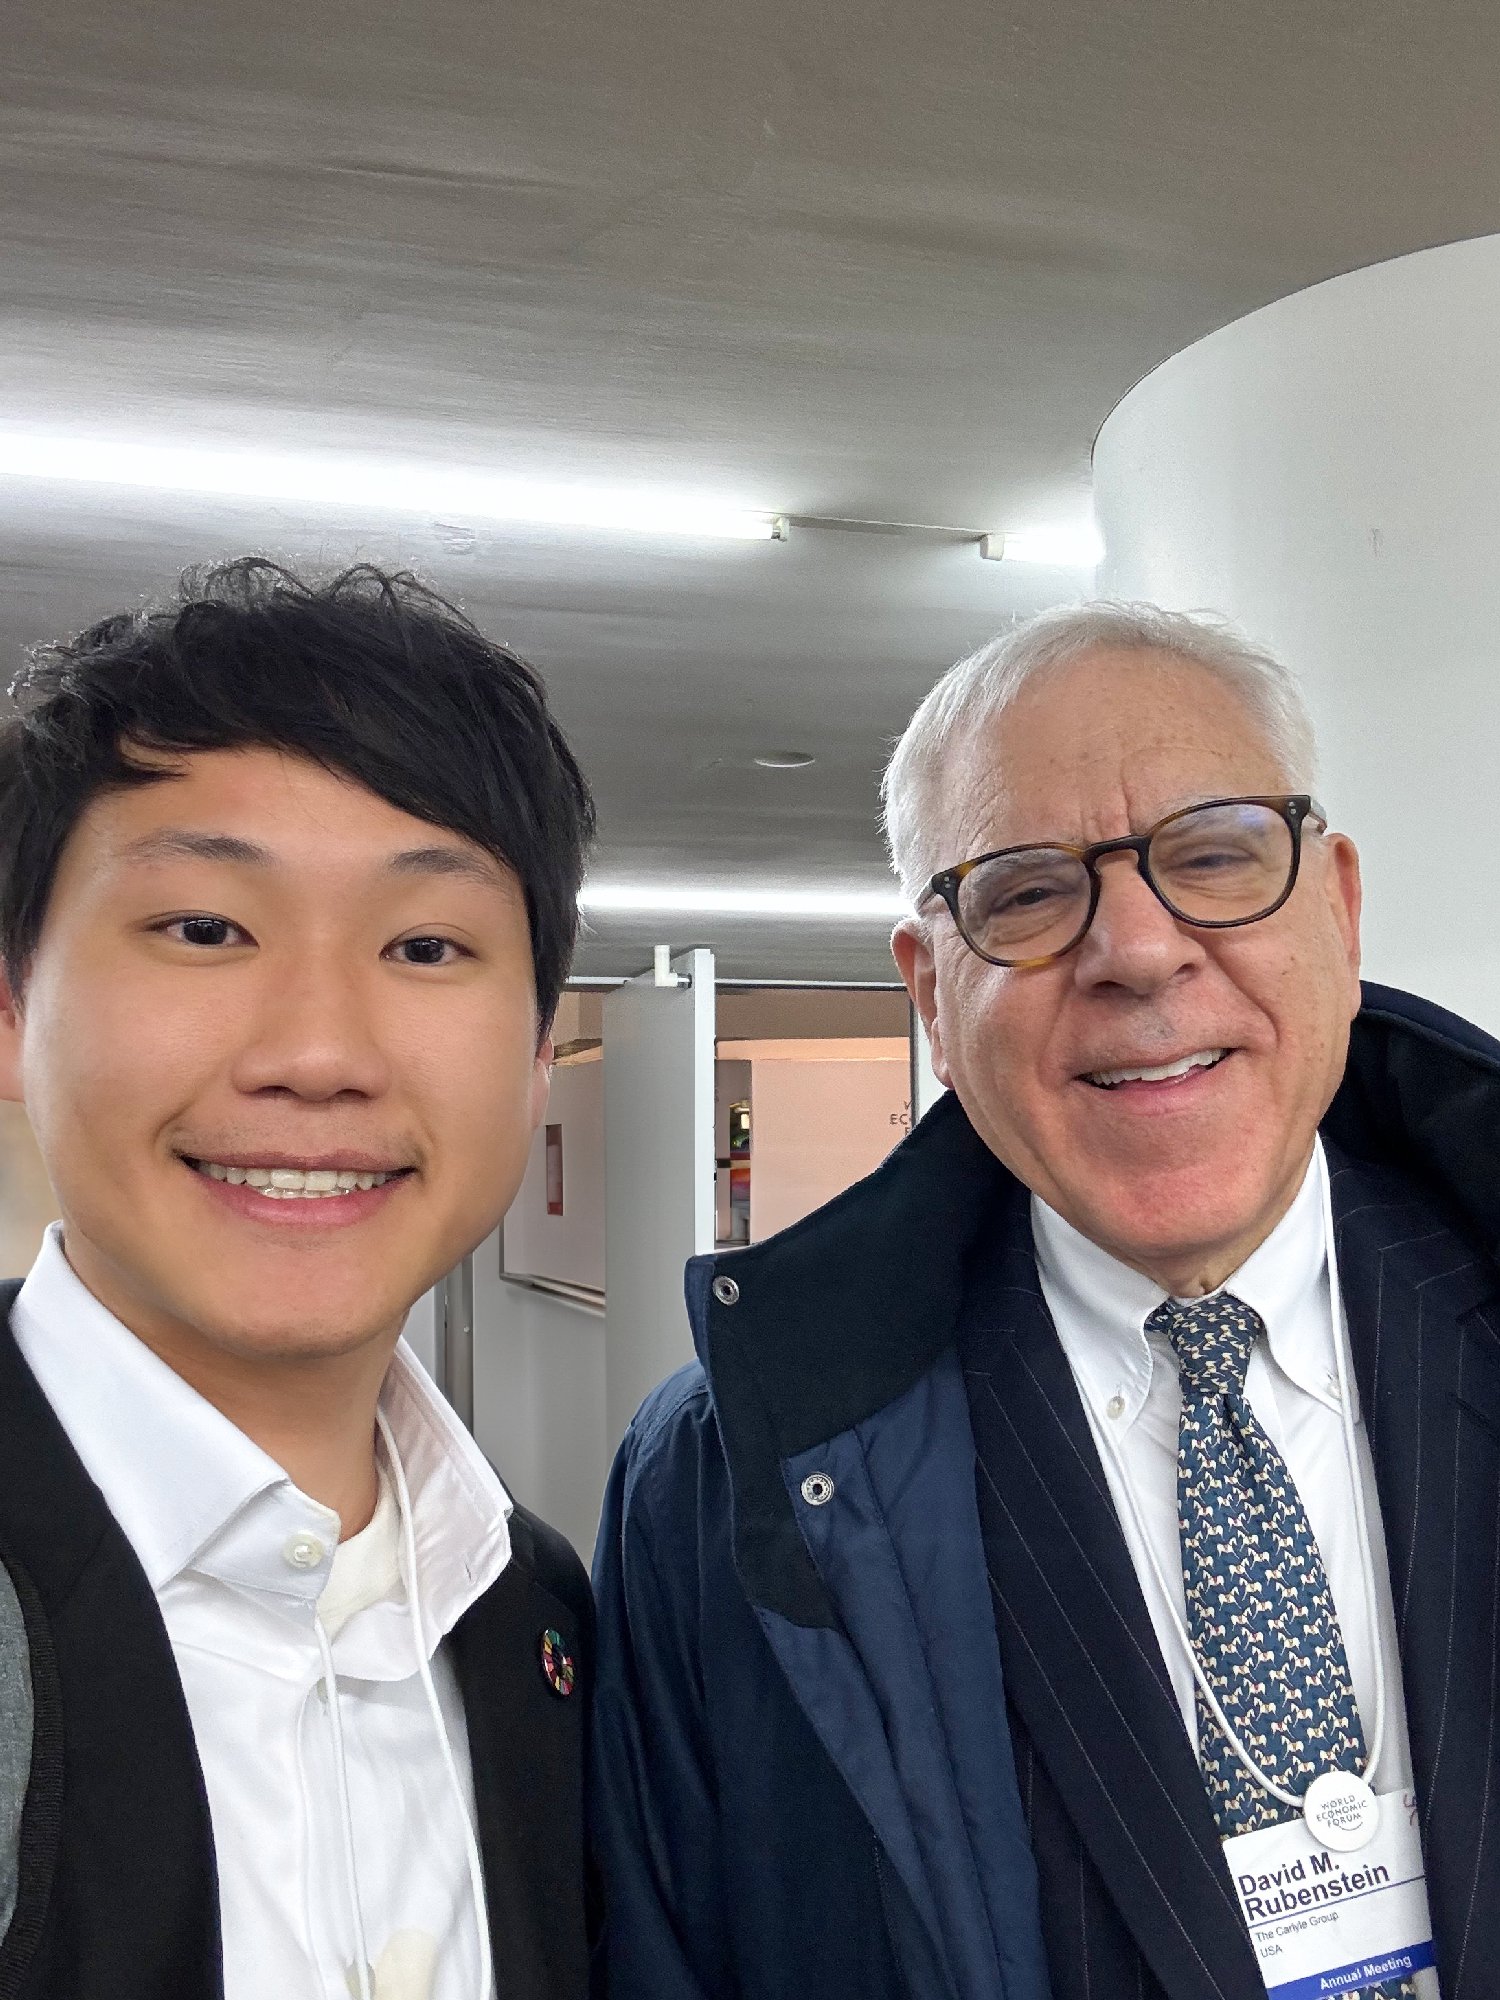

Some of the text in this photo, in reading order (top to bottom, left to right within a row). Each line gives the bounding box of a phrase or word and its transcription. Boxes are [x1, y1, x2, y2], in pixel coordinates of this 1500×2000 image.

[1316, 1800, 1368, 1822] ECONOMIC
[1321, 1795, 1356, 1810] WORLD
[1327, 1813, 1362, 1828] FORUM
[1238, 1852, 1340, 1897] David M.
[1244, 1864, 1391, 1921] Rubenstein
[1255, 1911, 1340, 1943] The Carlyle Group
[1260, 1944, 1283, 1958] USA
[1320, 1955, 1413, 1991] Annual Meeting
